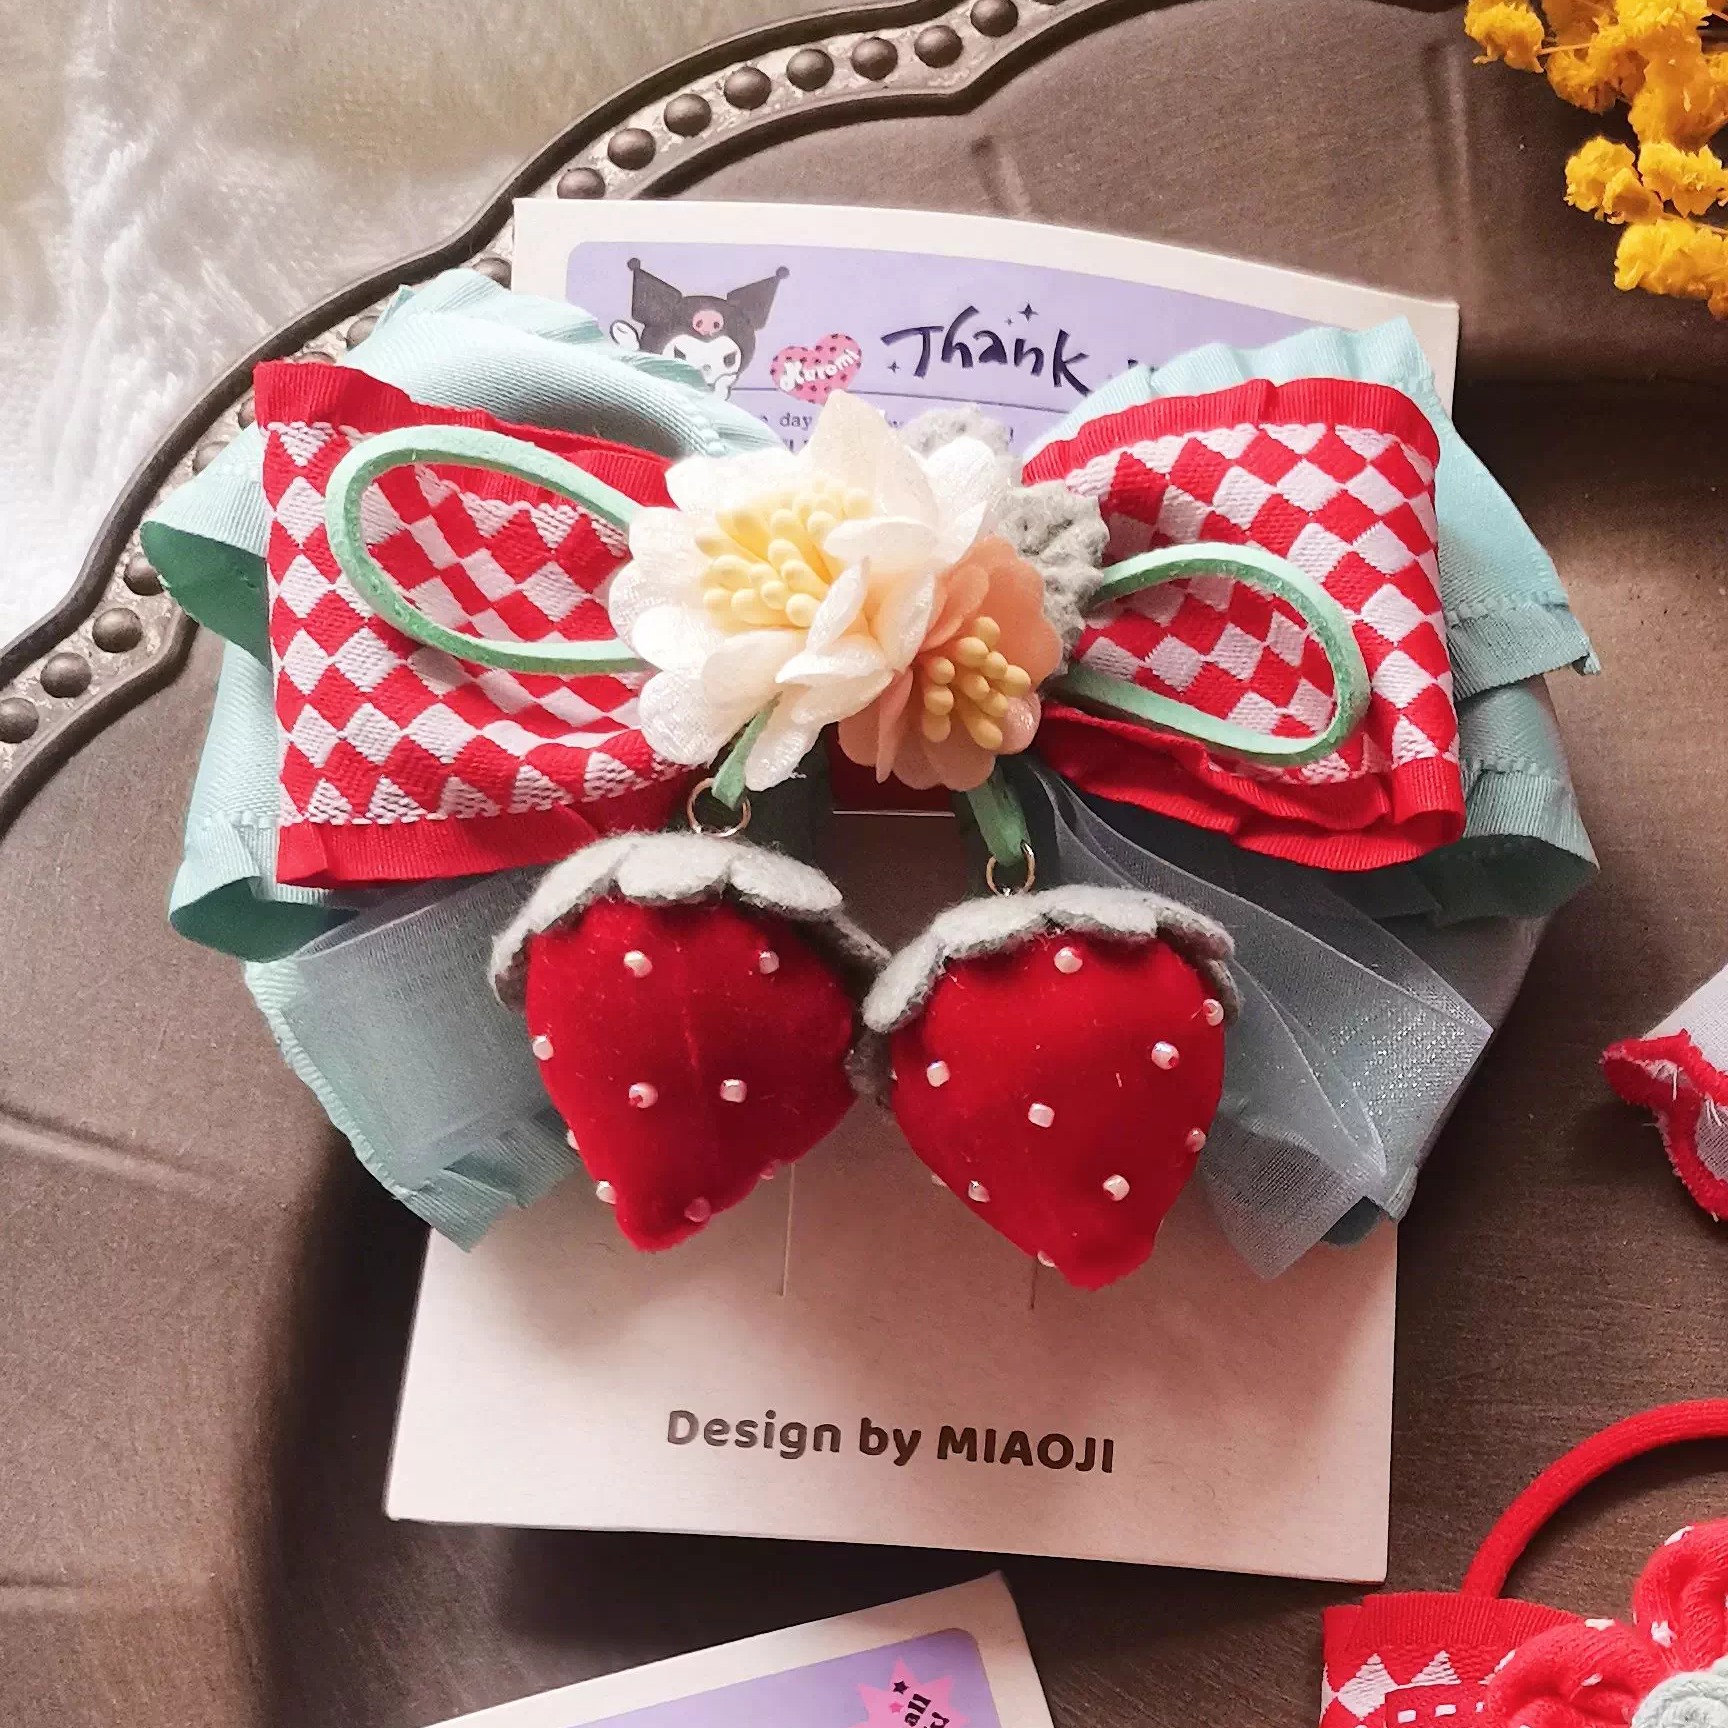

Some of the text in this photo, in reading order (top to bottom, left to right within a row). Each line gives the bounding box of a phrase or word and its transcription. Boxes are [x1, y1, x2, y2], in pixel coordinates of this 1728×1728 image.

[880, 305, 1093, 397] Thank
[780, 412, 813, 431] day
[667, 1409, 1116, 1474] Design by MIAOJI
[904, 1693, 932, 1727] all
